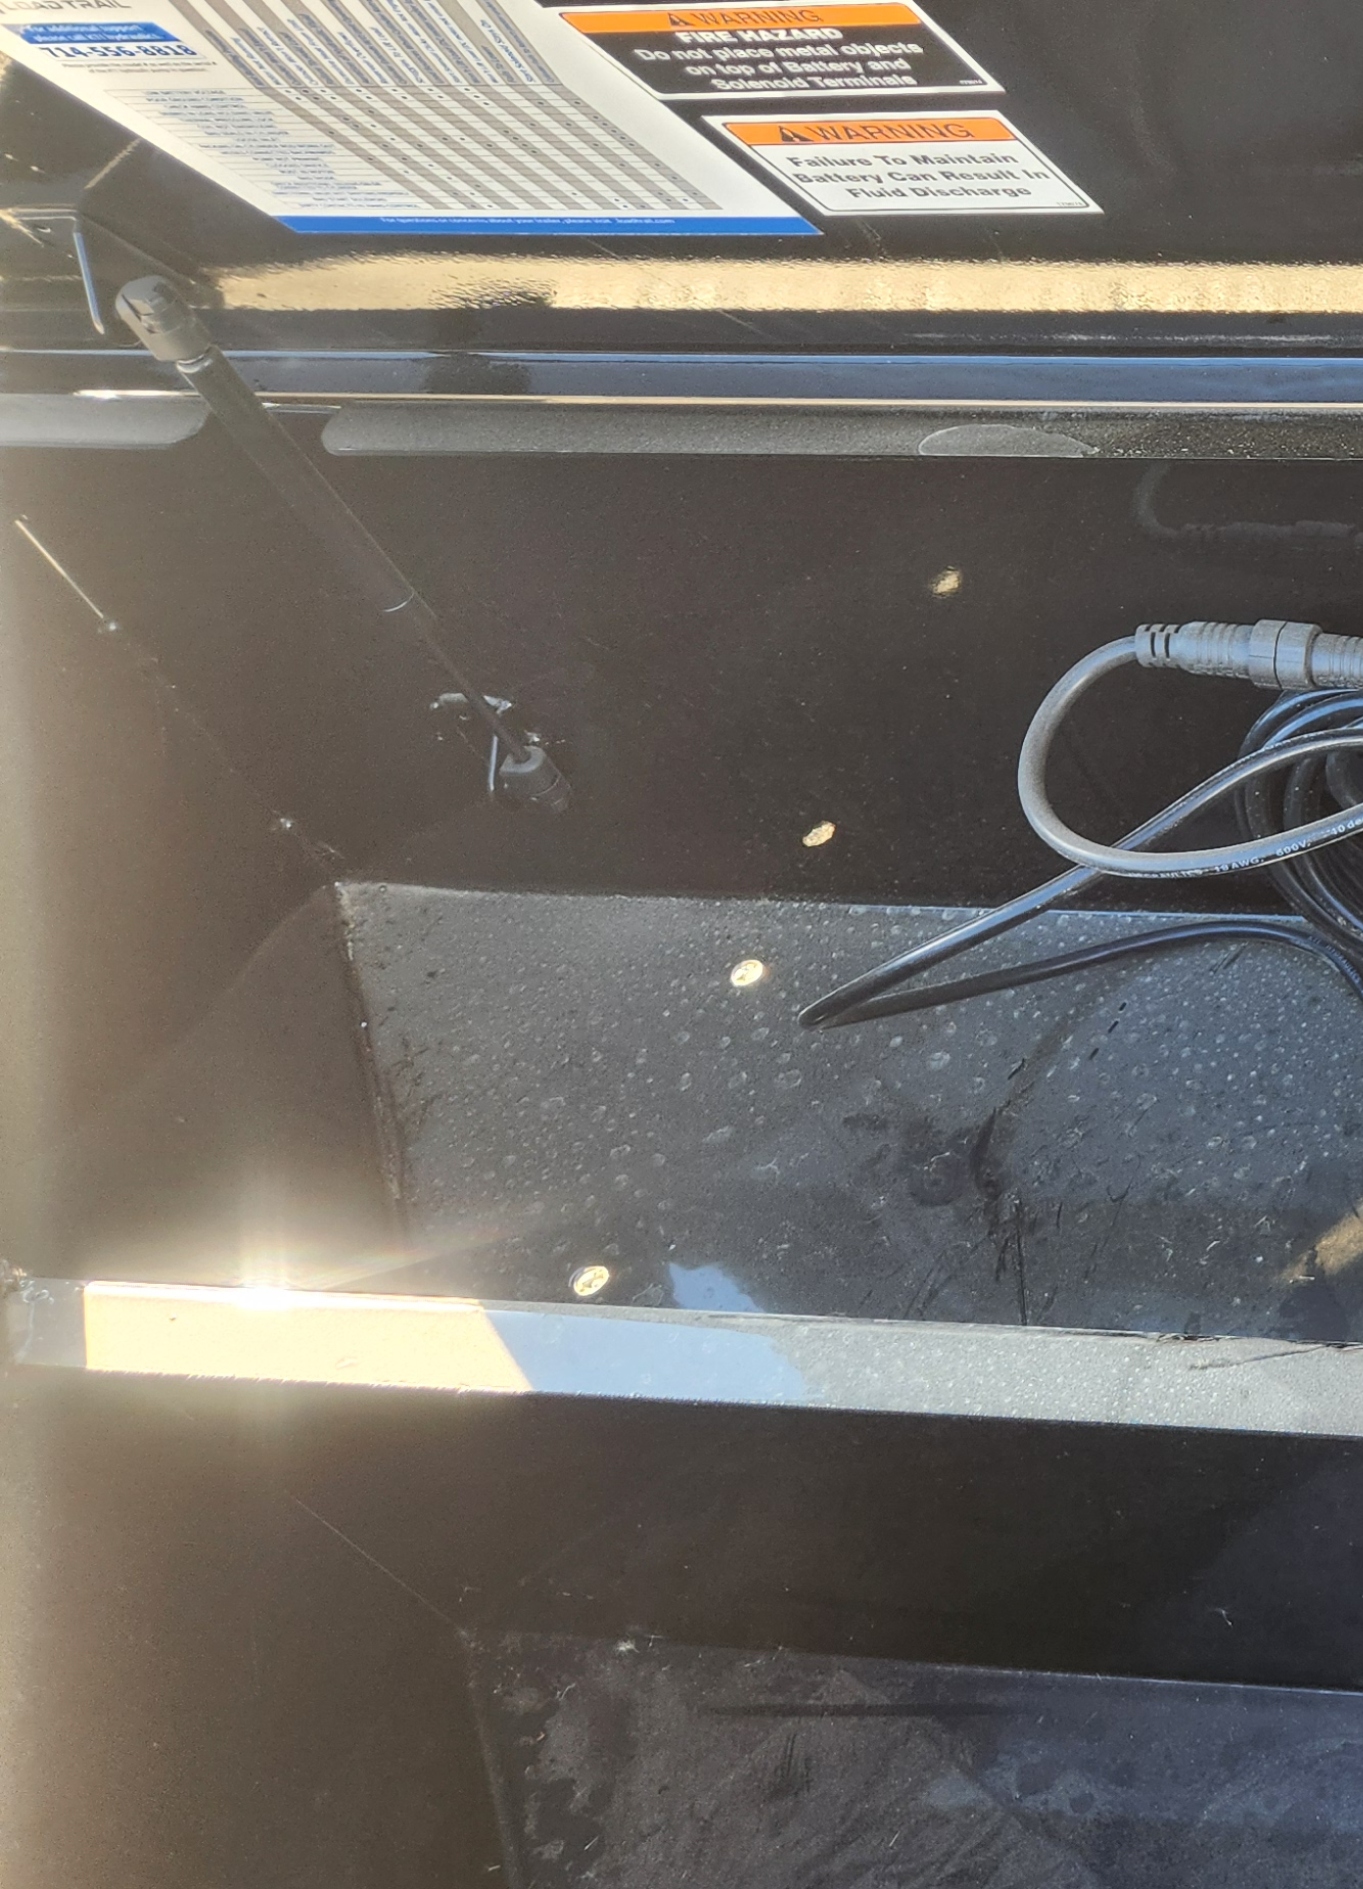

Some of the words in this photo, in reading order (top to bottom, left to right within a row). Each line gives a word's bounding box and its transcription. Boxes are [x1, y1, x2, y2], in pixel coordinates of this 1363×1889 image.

[690, 9, 824, 26] WARNING
[675, 29, 738, 44] FIRE
[742, 27, 843, 43] HAZARD
[39, 44, 198, 58] 714-556-8818
[634, 48, 671, 62] Do
[672, 47, 715, 61] not
[717, 46, 774, 63] place
[775, 44, 839, 58] metal
[839, 42, 924, 58] objects
[685, 64, 717, 76] on
[716, 62, 754, 77] top
[756, 61, 784, 75] of
[786, 60, 865, 77] Battery
[867, 57, 911, 72] and
[711, 77, 810, 92] Solenoid
[809, 75, 918, 89] Terminals
[805, 123, 975, 142] WARNING
[786, 154, 872, 168] Failure
[875, 154, 908, 166] To
[911, 153, 1020, 166] Maintain
[792, 172, 884, 185] Battery
[888, 171, 938, 183] Can
[941, 170, 1021, 182] Result
[1022, 168, 1051, 181] In
[845, 187, 907, 199] Fluid
[911, 186, 1032, 199] Discharge
